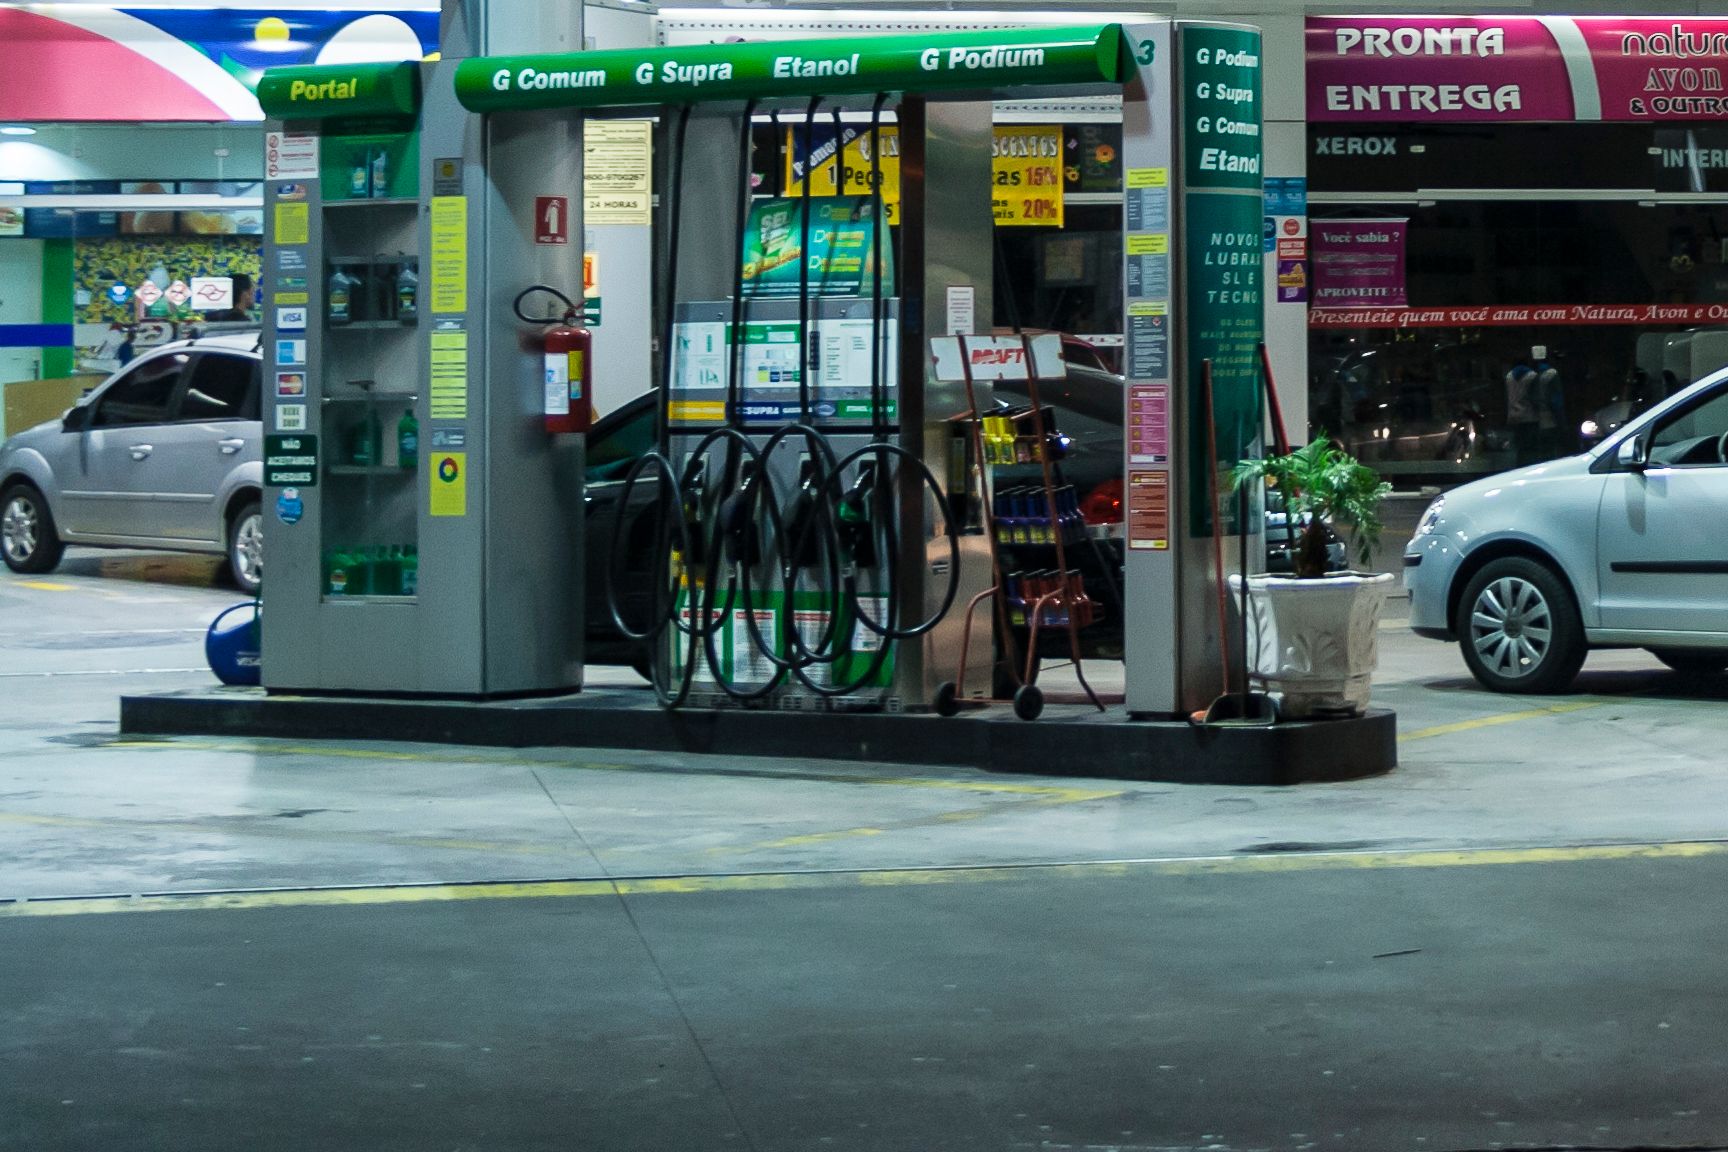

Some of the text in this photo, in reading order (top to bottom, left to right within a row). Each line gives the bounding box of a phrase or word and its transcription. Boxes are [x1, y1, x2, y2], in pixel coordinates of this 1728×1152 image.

[1137, 39, 1155, 66] 3
[1335, 27, 1504, 58] PRONTA
[773, 54, 859, 78] Etanol
[921, 44, 1045, 71] G Podium
[1197, 48, 1258, 68] G Podium
[493, 67, 606, 91] G Comum
[635, 59, 733, 86] G Supra
[291, 78, 357, 101] Portal
[1197, 83, 1253, 104] G Supra
[1326, 84, 1522, 114] ENTREGA
[1630, 98, 1646, 114] &
[1197, 117, 1259, 136] G Comum
[1316, 137, 1397, 156] XEROX
[1200, 148, 1260, 174] Etanol
[992, 171, 1021, 186] as
[1026, 167, 1058, 186] 15%
[1023, 198, 1057, 219] 20%
[1211, 233, 1258, 247] NOVOS
[1323, 232, 1352, 243] Você
[1356, 232, 1389, 243] sabia
[1222, 272, 1254, 285] SL E
[1315, 288, 1389, 297] APROVEITE
[1309, 308, 1395, 323] Presenteie
[1398, 311, 1445, 327] quem
[1451, 305, 1491, 323] você
[1494, 309, 1530, 322] ama
[1534, 308, 1566, 321] com
[1571, 304, 1638, 323] Natura,
[1639, 304, 1689, 322] Avon
[1694, 307, 1705, 320] e
[748, 406, 779, 415] SUPRA
[271, 472, 311, 481] CHEQUES
